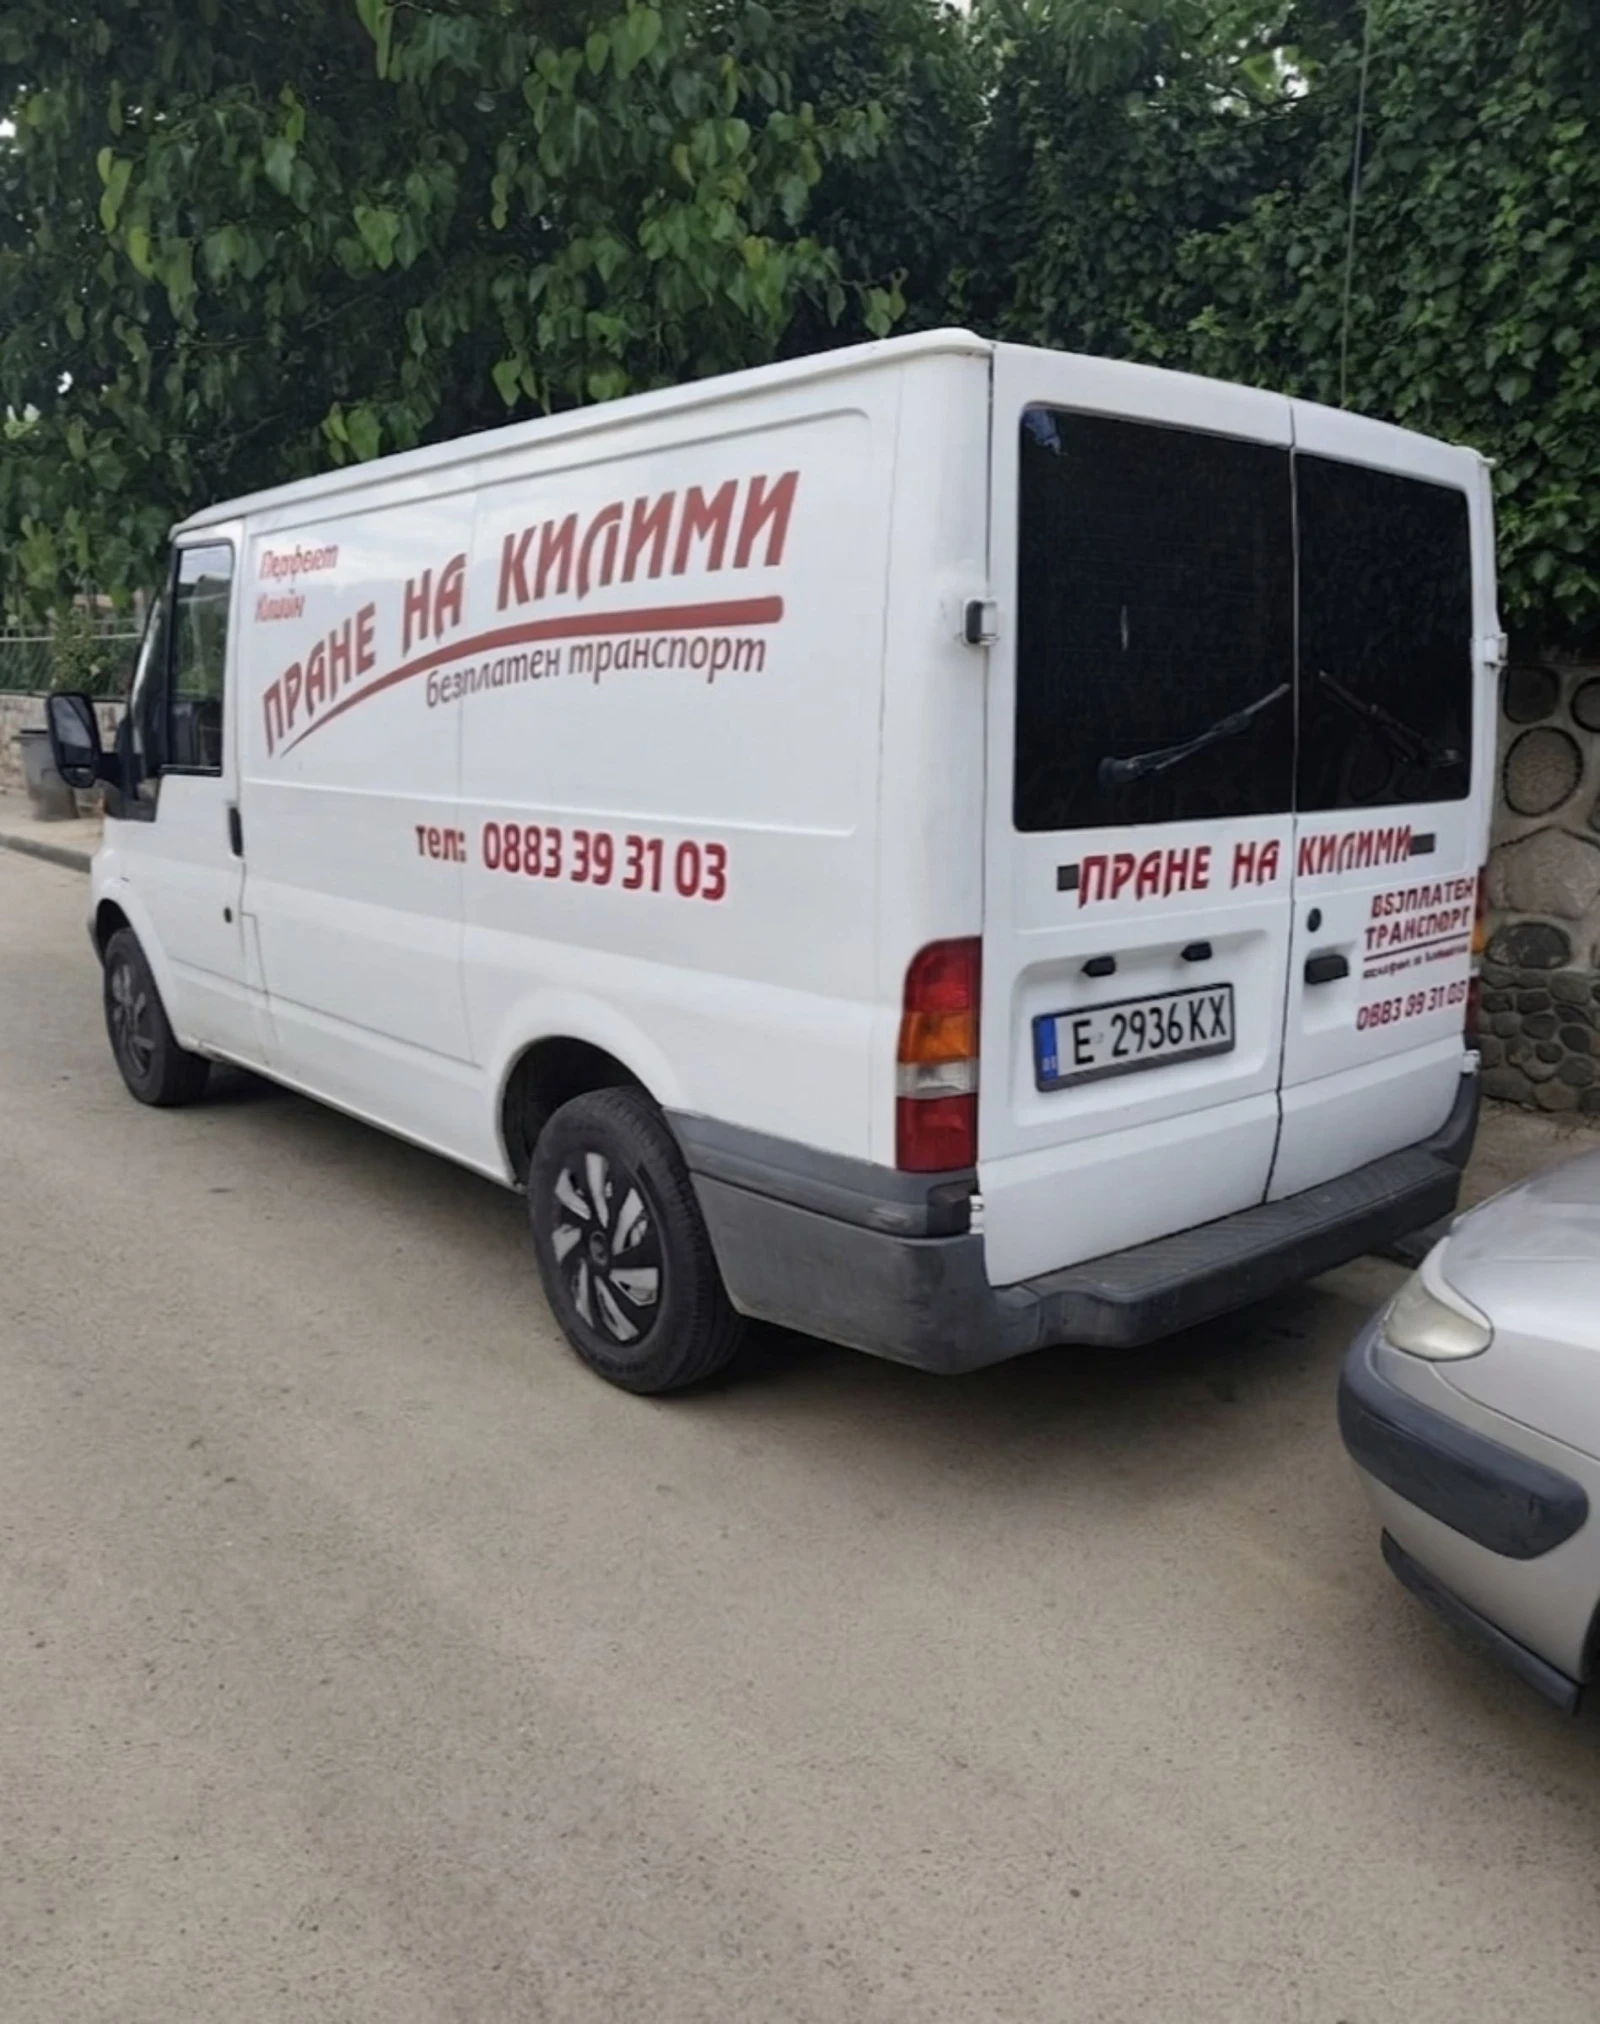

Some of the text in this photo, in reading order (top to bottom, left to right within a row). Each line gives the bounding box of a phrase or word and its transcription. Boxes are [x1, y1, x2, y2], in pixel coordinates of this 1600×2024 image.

[262, 470, 799, 757] ПРАНЕ НА КИЛИМИ
[425, 635, 767, 708] безплатен транспорт
[415, 824, 466, 862] тел:
[482, 821, 727, 901] 0883 39 31 03
[1078, 824, 1412, 909] ПРАНЕ НА КИЛИМИ
